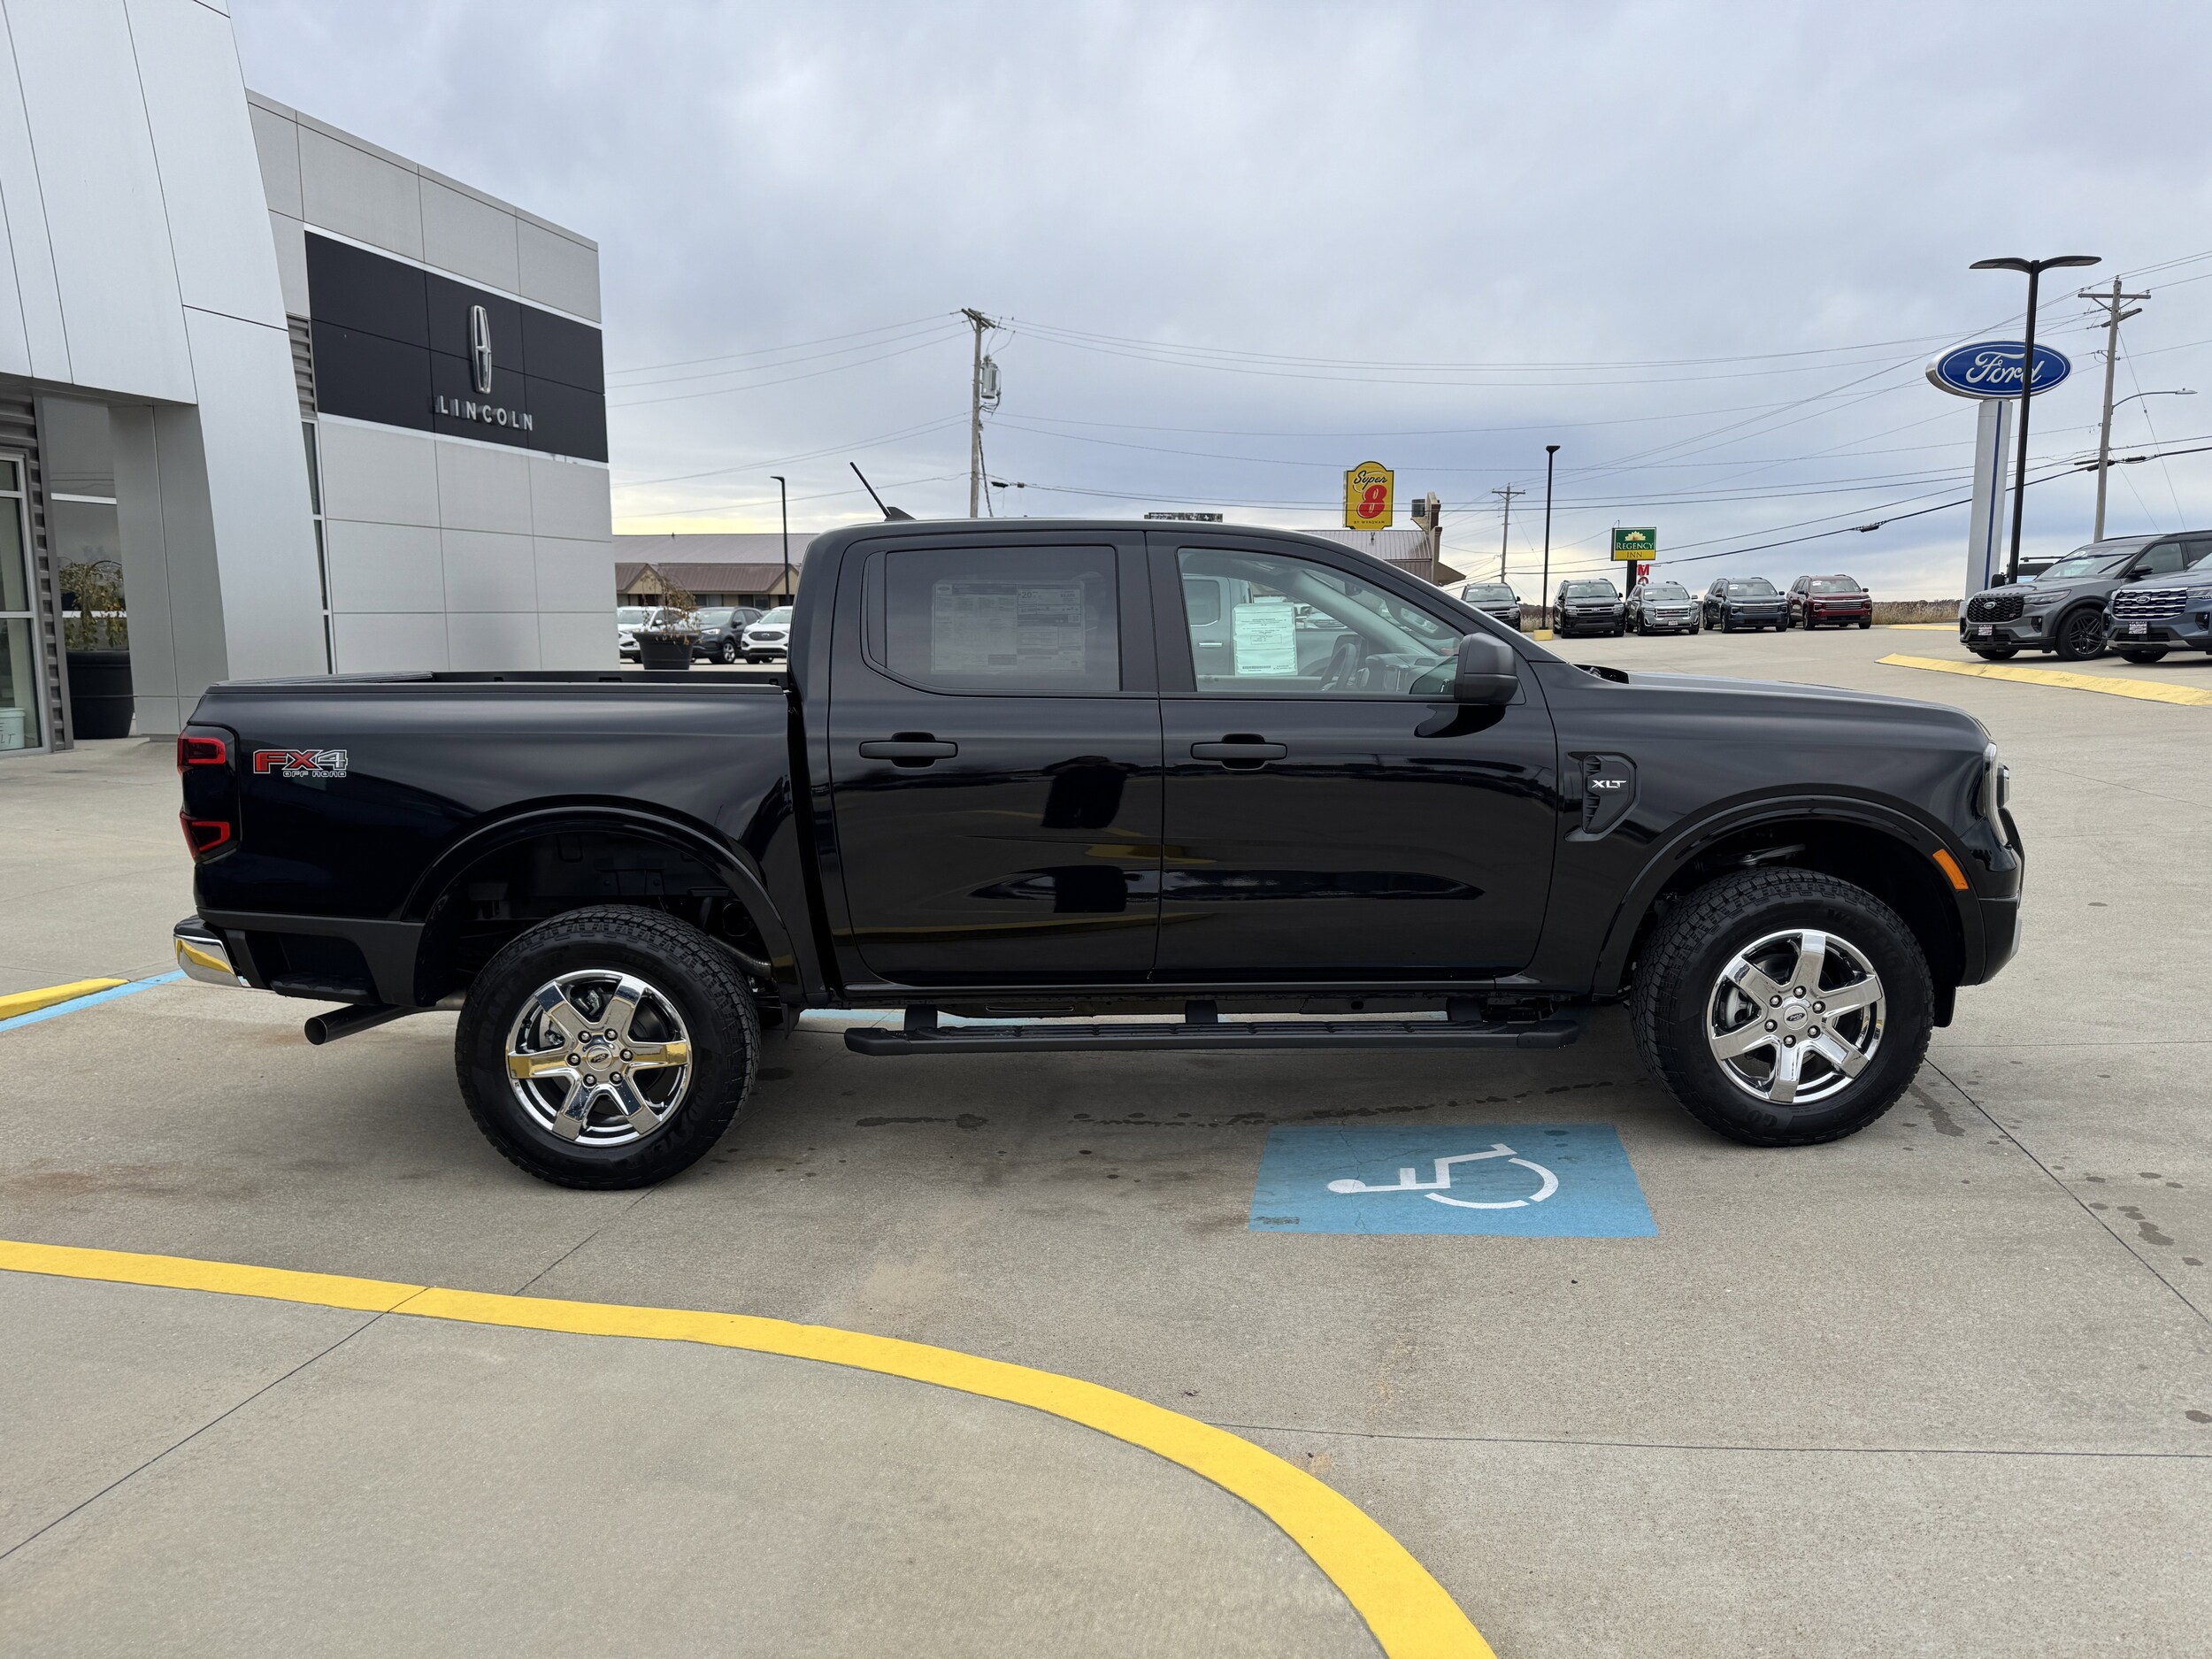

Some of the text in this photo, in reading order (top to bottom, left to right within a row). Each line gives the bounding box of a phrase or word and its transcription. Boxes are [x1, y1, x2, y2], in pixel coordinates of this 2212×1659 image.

[1965, 351, 2045, 384] Ford
[437, 396, 533, 431] LINCOLN
[1353, 470, 1387, 491] Super
[1356, 484, 1387, 518] 8
[253, 749, 349, 774] FX4
[1592, 780, 1627, 789] XLT
